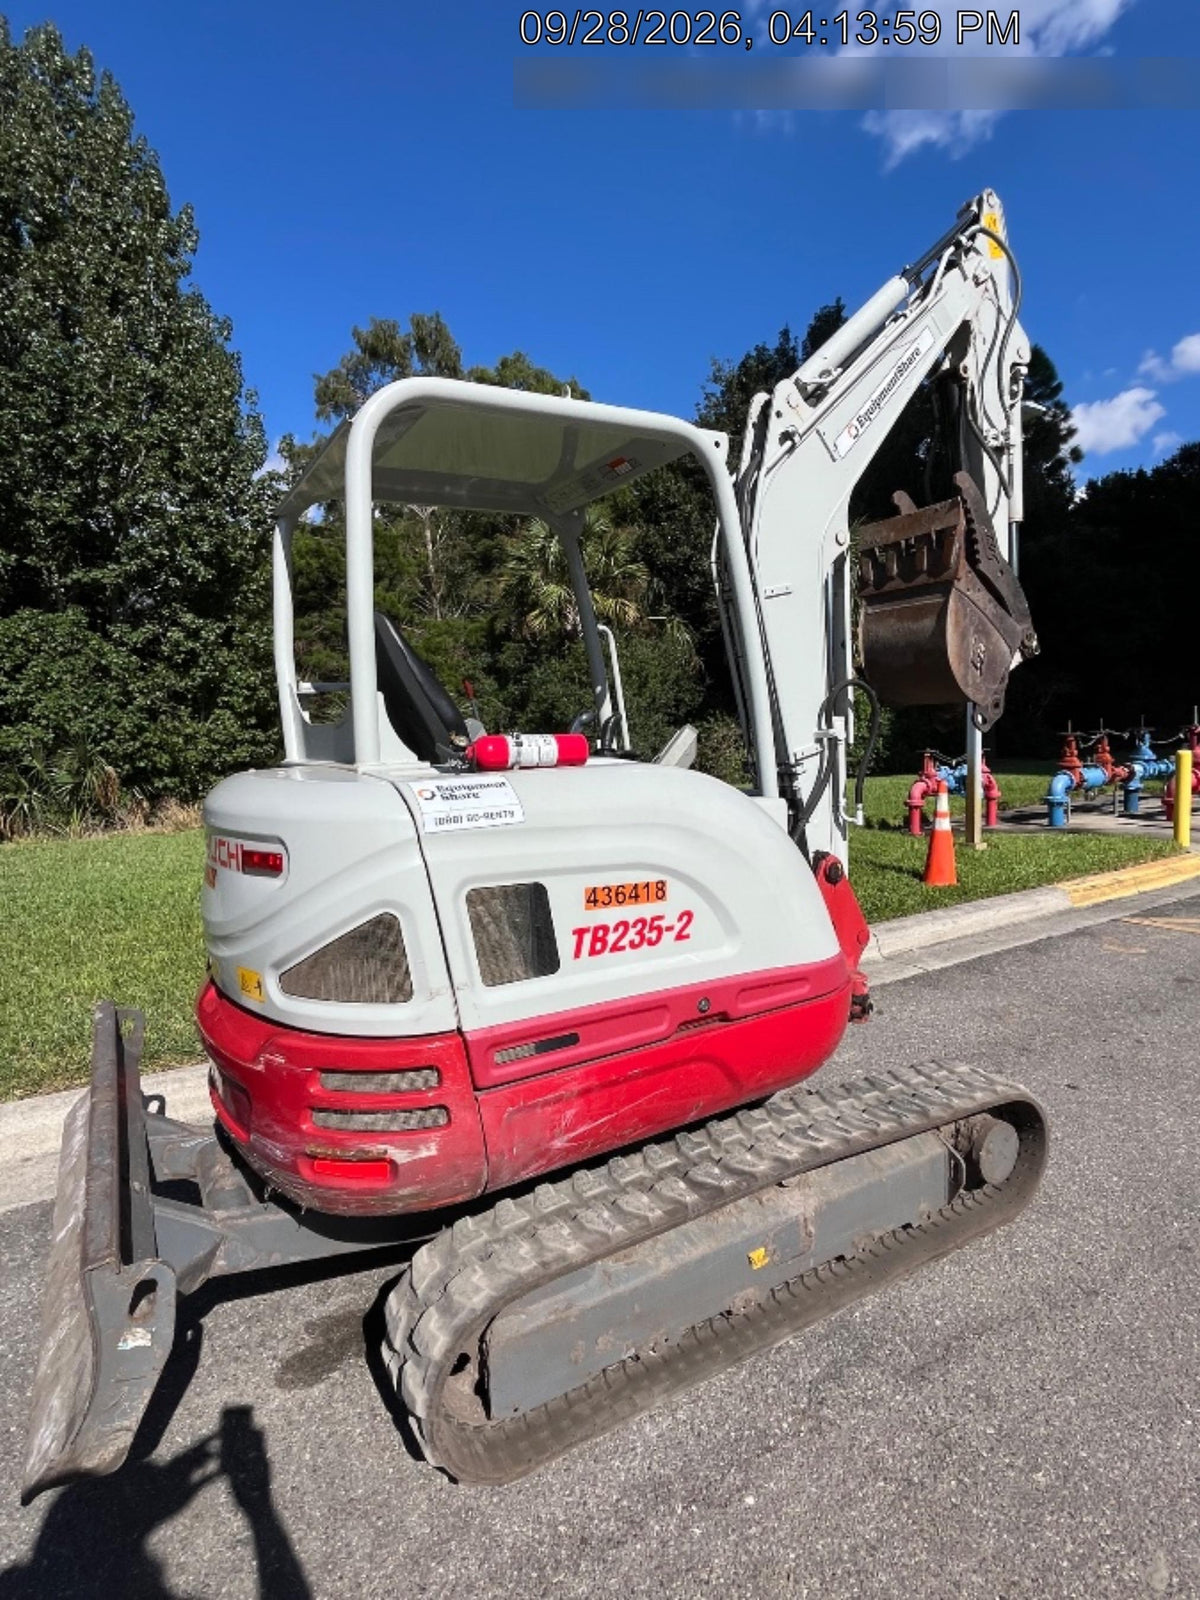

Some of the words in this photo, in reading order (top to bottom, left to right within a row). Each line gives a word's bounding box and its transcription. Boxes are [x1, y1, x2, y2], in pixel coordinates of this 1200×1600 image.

[857, 347, 921, 429] EquipmentShare
[436, 782, 506, 793] Equipment
[440, 793, 480, 801] Share
[586, 880, 666, 907] 436418
[572, 909, 694, 960] TB235-2
